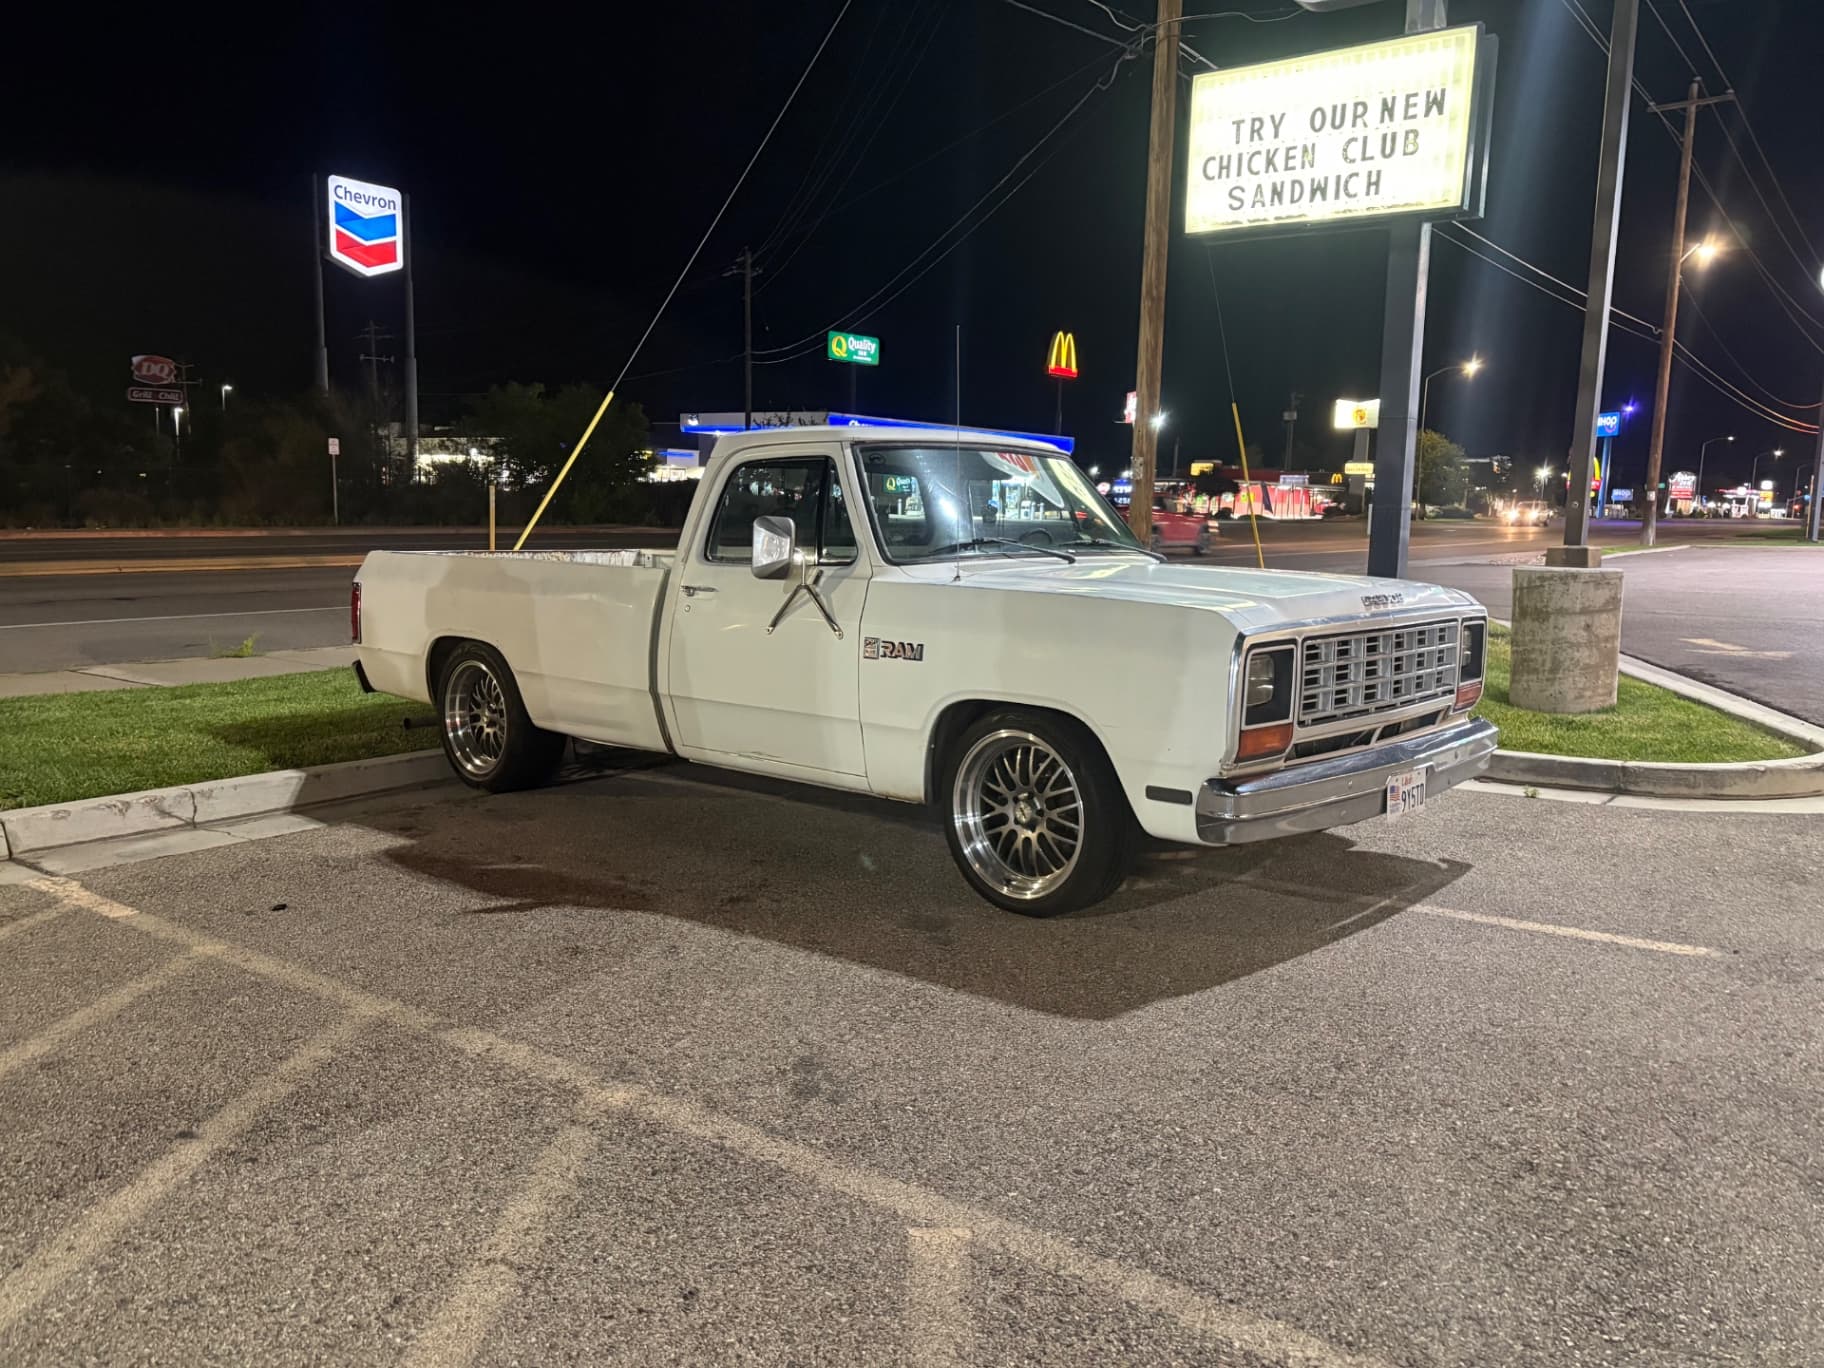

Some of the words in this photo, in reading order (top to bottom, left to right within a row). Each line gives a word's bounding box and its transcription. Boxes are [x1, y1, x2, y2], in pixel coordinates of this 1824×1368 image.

[1232, 112, 1287, 144] TRY
[1310, 100, 1369, 133] OUR
[1379, 87, 1447, 124] NEW
[1202, 142, 1316, 181] CHICKEN
[1342, 128, 1420, 164] CLUB
[334, 184, 397, 211] Chevron
[1228, 169, 1383, 211] SANDWICH
[848, 336, 876, 354] Quality
[880, 640, 924, 662] RAM
